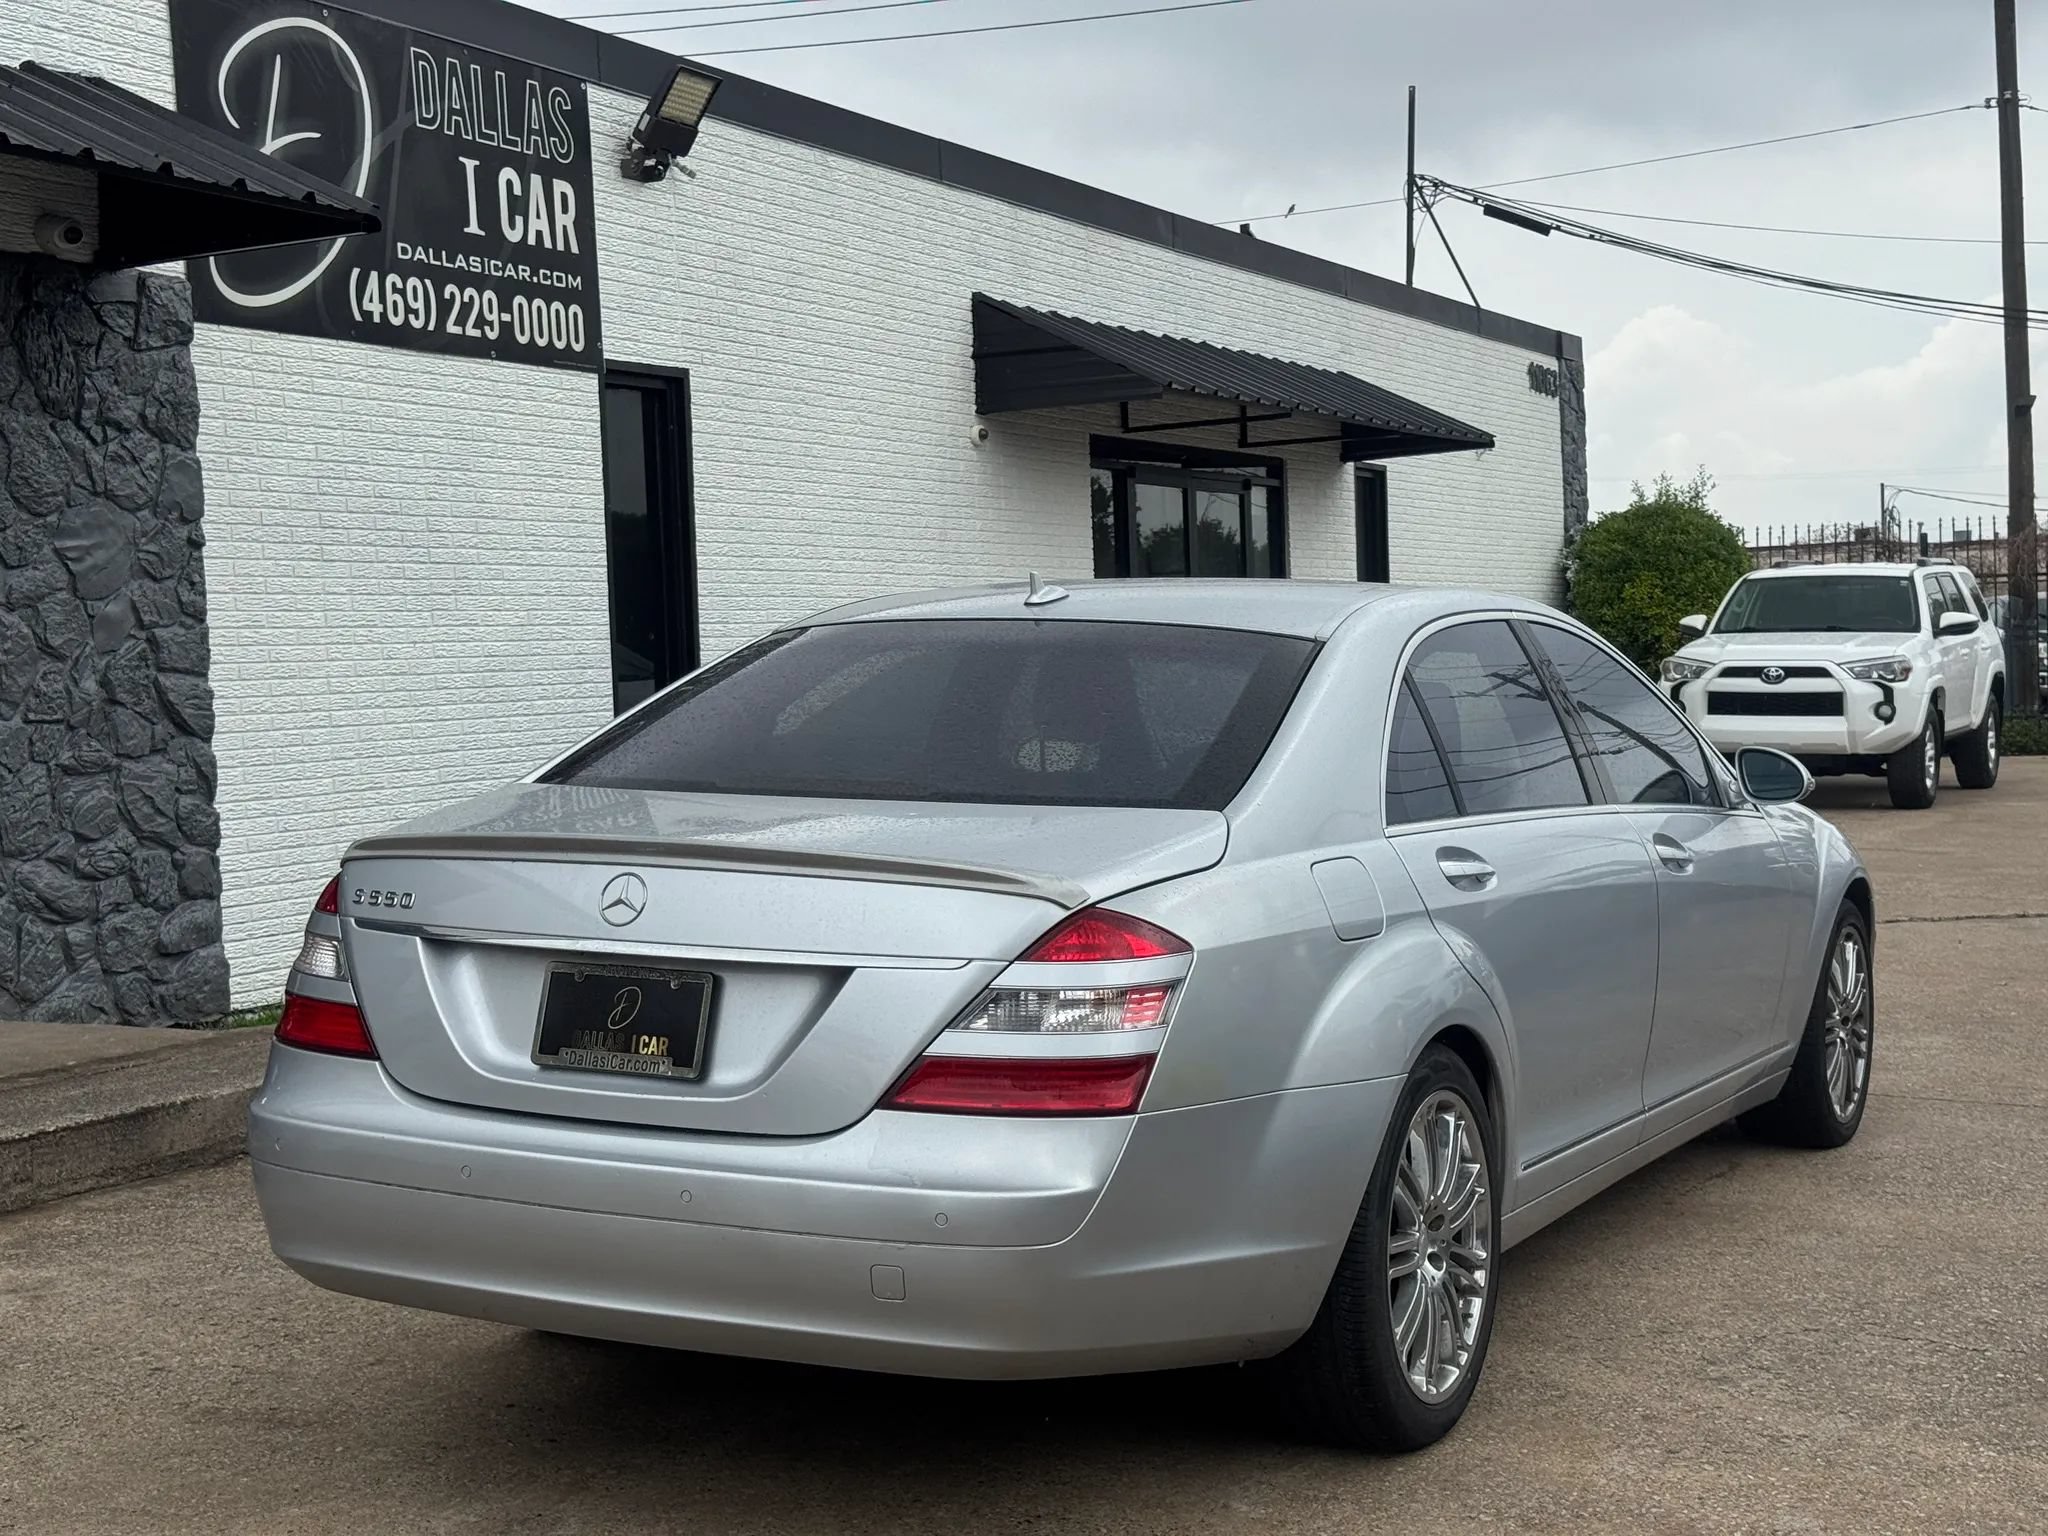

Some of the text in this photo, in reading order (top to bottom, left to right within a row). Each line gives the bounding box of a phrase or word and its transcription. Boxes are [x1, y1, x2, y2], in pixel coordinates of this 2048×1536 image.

[410, 47, 575, 164] DALLAS
[458, 156, 580, 254] I CAR
[396, 241, 583, 291] DALLASICAR.COM
[349, 267, 585, 353] (469) 229-0000
[352, 888, 416, 909] S550
[567, 1049, 662, 1073] DallasiCar.com
[639, 1034, 670, 1056] CAR
